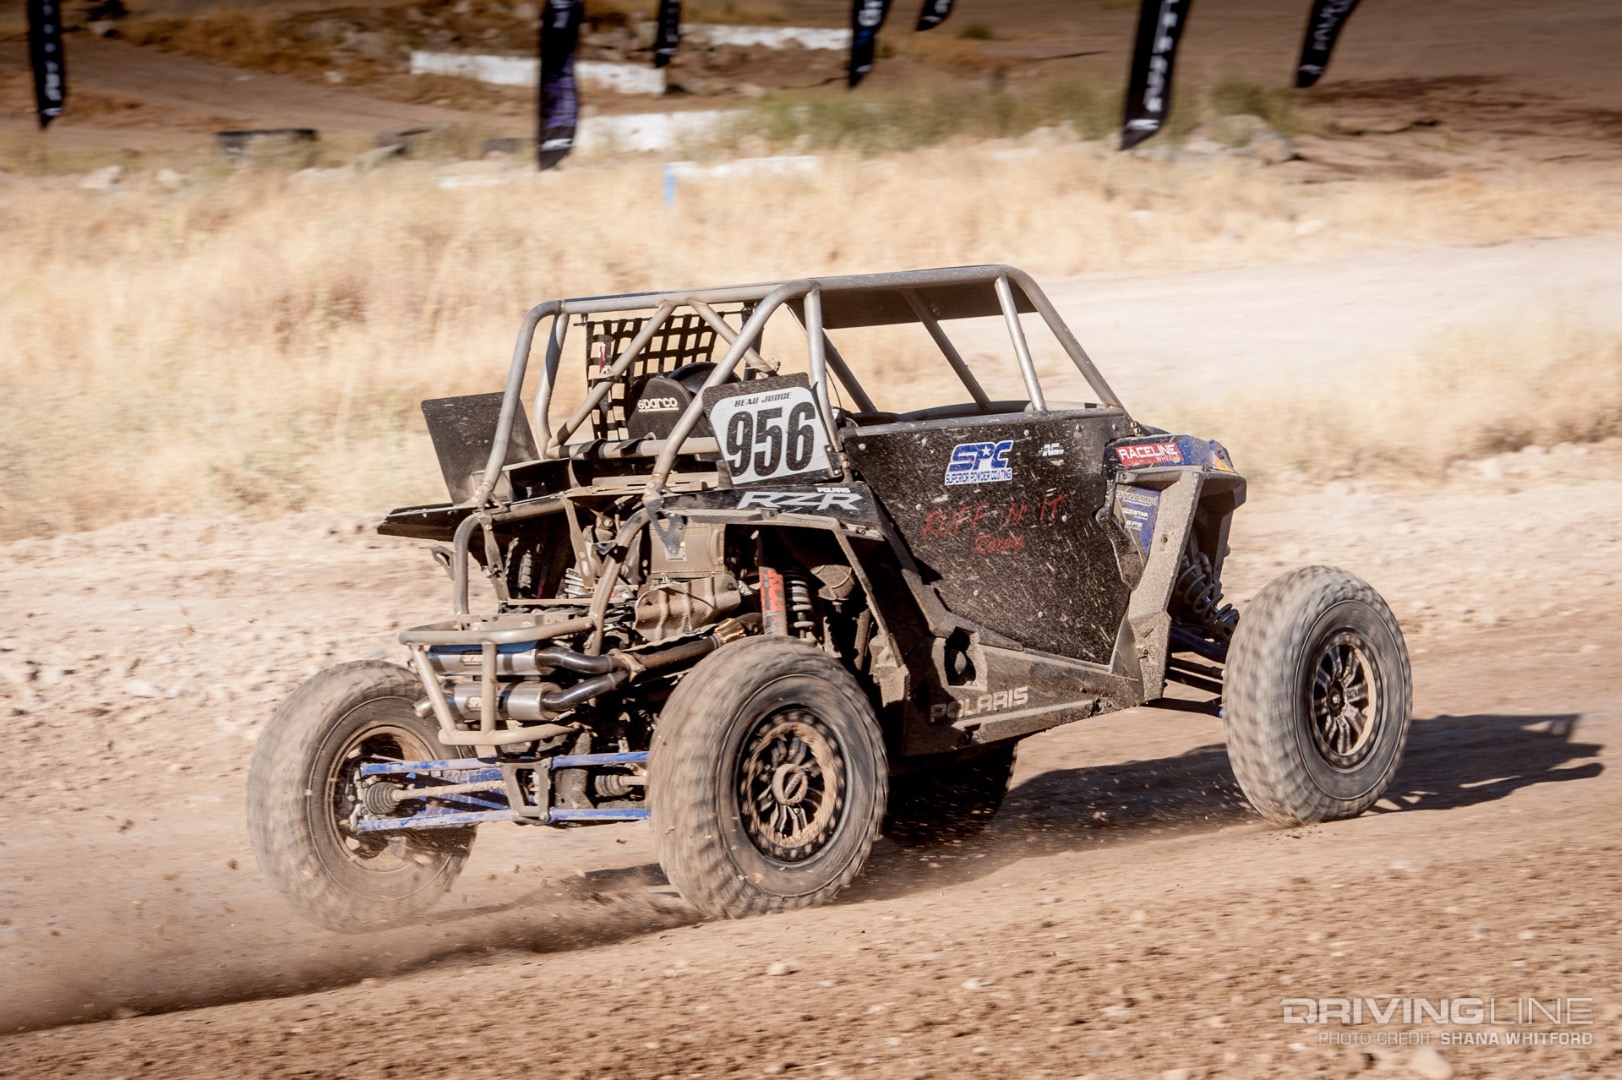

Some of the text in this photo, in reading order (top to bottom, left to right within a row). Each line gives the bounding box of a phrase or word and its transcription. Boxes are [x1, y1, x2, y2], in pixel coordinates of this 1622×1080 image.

[637, 397, 678, 412] sparco
[734, 392, 792, 407] BEAU JUDGE
[727, 401, 816, 477] 956
[948, 440, 1013, 472] SPC
[1118, 444, 1178, 460] RACELINE
[945, 471, 970, 484] SUPERIOR
[971, 470, 991, 482] POWDER
[736, 491, 862, 510] RZR
[930, 686, 1028, 723] POLARIS
